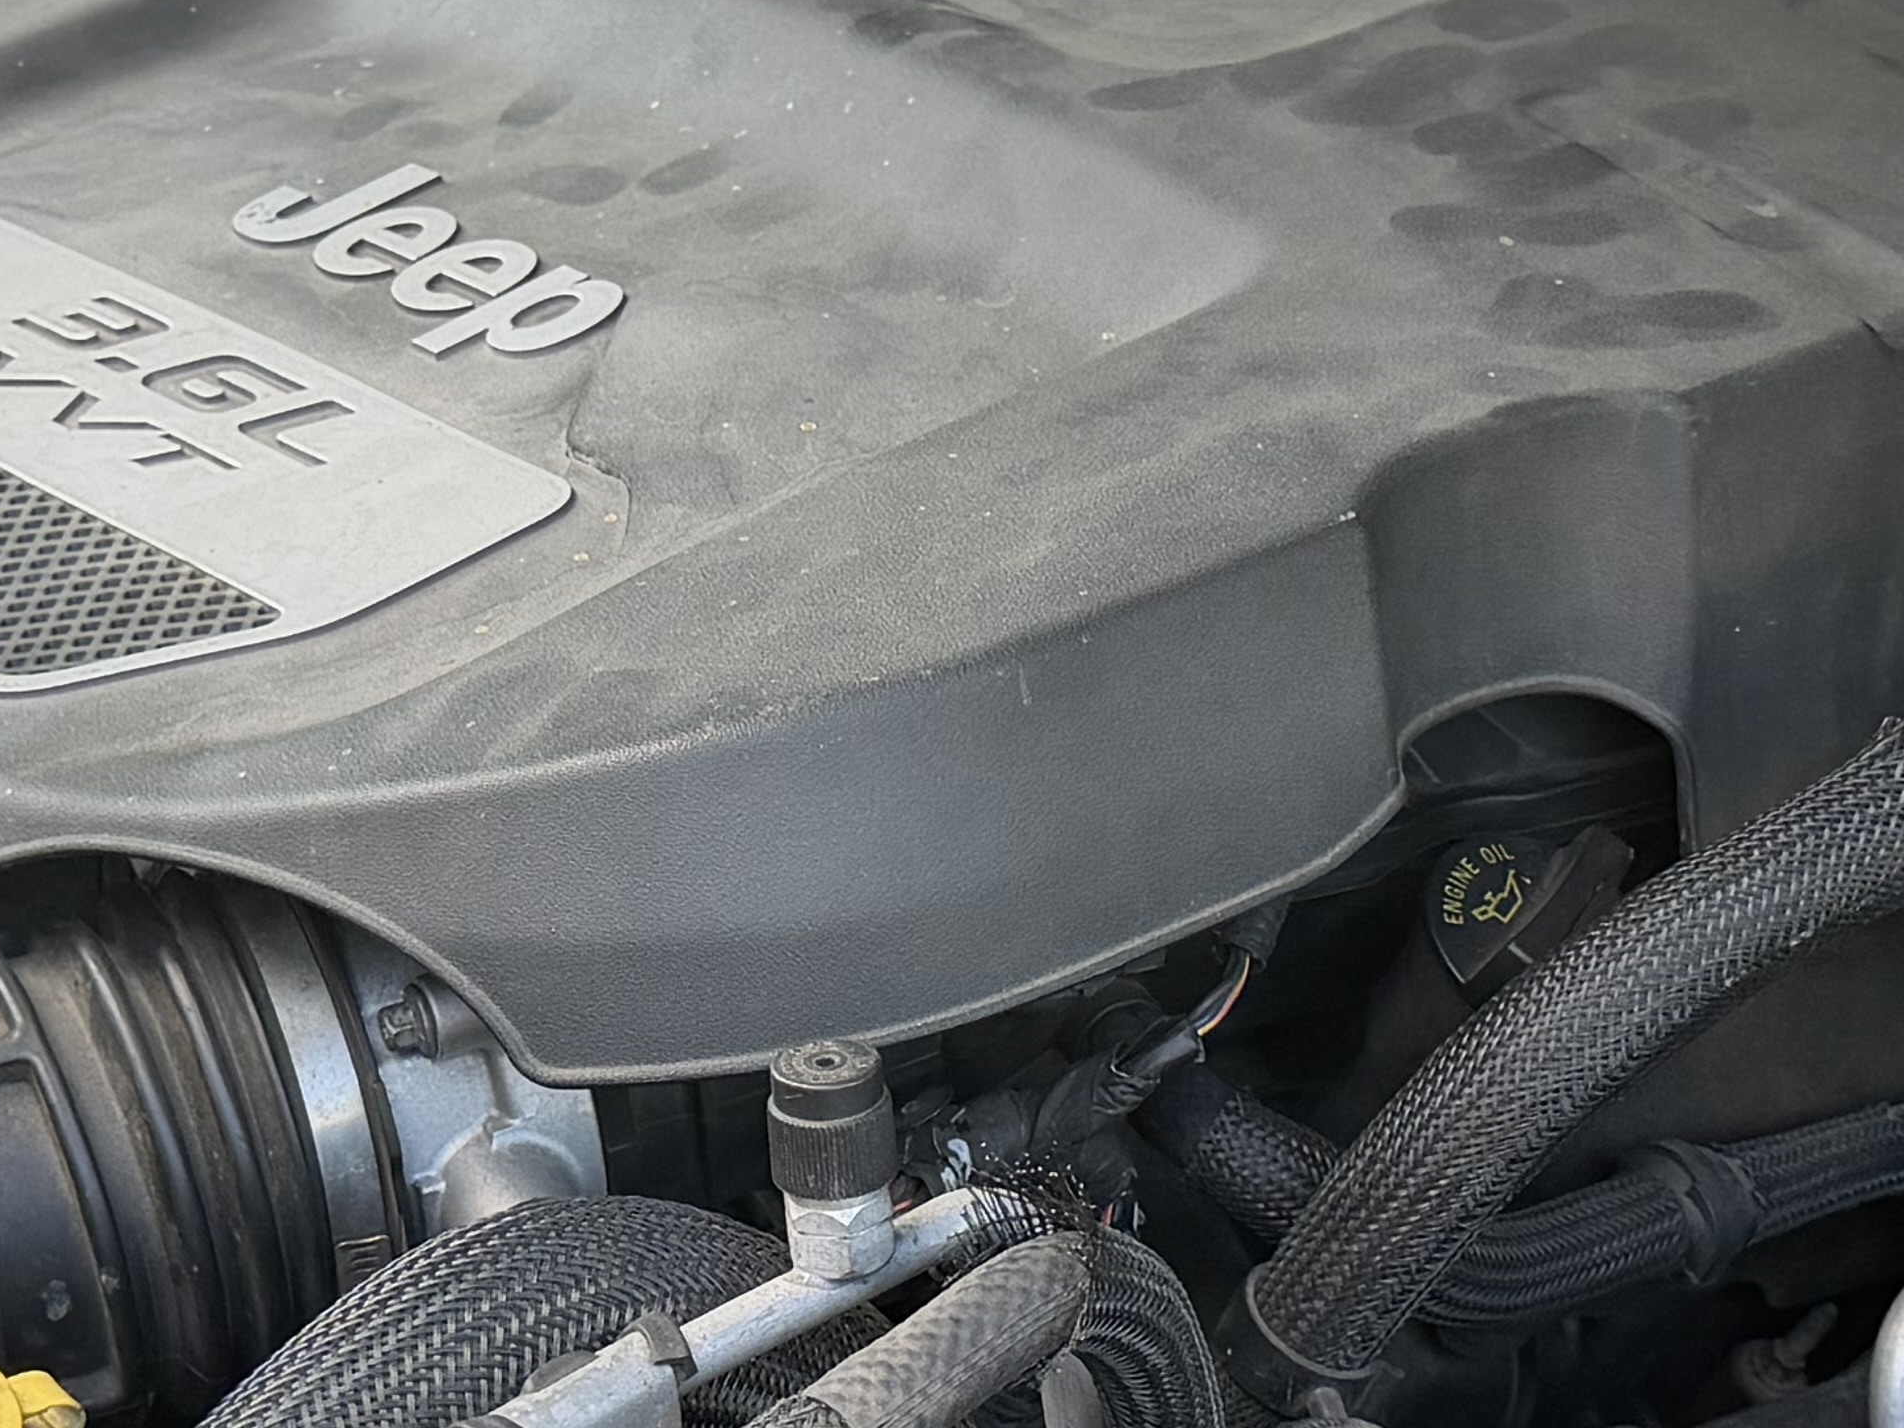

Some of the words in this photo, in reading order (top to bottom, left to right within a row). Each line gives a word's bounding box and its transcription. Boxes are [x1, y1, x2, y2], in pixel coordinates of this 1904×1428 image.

[232, 163, 626, 355] Jeep
[10, 295, 356, 468] 3.6L
[1443, 857, 1482, 925] ENGINE
[1480, 843, 1515, 865] OIL
